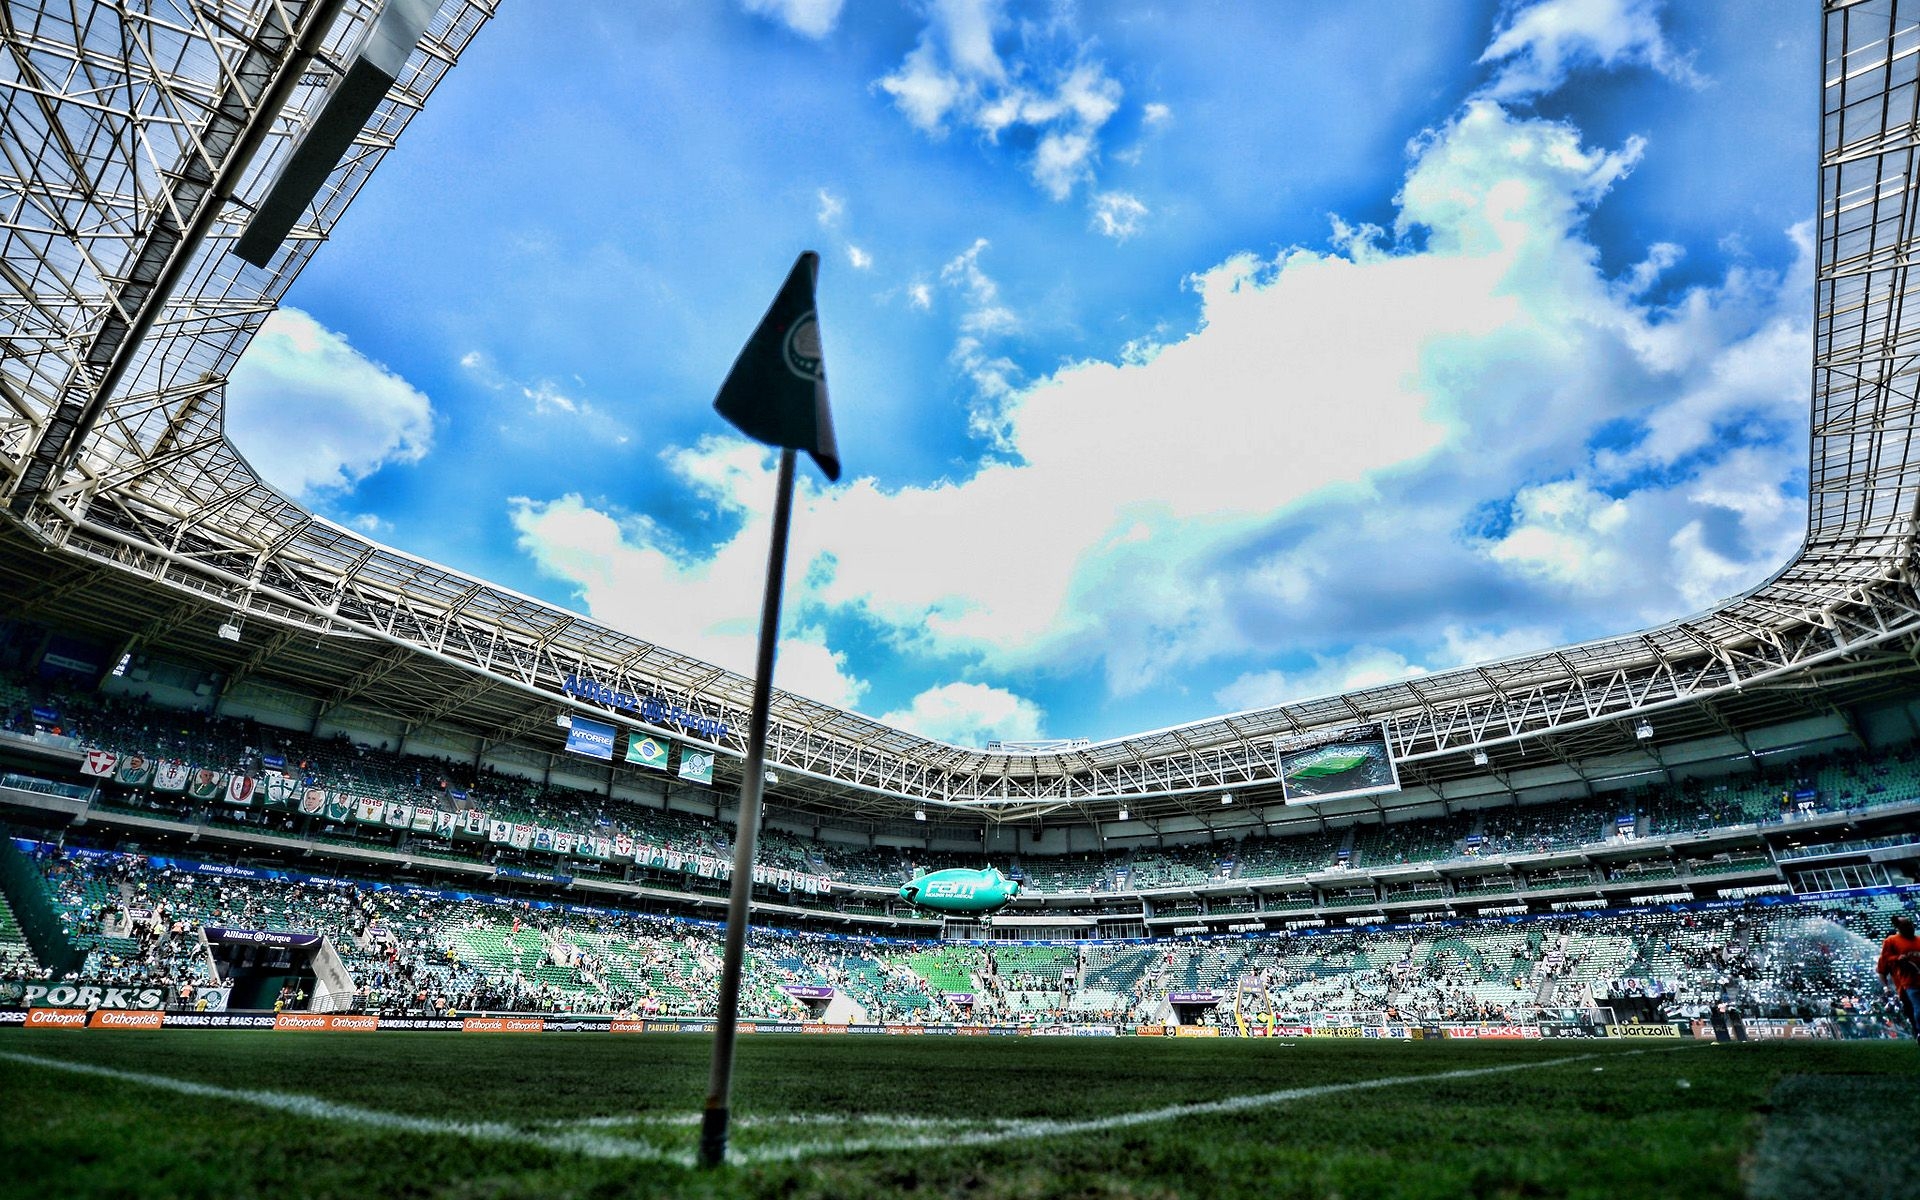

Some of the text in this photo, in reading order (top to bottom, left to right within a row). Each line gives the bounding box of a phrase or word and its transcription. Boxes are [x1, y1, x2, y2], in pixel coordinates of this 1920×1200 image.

[562, 673, 730, 739] Allianz Parque
[361, 796, 383, 807] 1915
[416, 808, 434, 816] 1920
[515, 824, 532, 833] 1951
[199, 863, 255, 876] Allianz Parque
[223, 930, 291, 944] Allianz Parque
[25, 985, 162, 1010] PORK'S
[101, 1012, 159, 1026] Orthopride
[210, 1016, 230, 1027] QUE
[229, 1016, 254, 1027] MAIS
[253, 1016, 277, 1027] CRES
[278, 1016, 326, 1027] Orthopride
[331, 1017, 375, 1029] Orthopride
[413, 1020, 428, 1029] QUE
[428, 1020, 447, 1029] MAIS
[465, 1018, 503, 1030] Orthopride
[506, 1020, 541, 1031] Orthopride
[612, 1022, 641, 1032] Orthopride
[647, 1022, 680, 1032] PAULISTÃO
[1480, 1026, 1540, 1037] BOKKER
